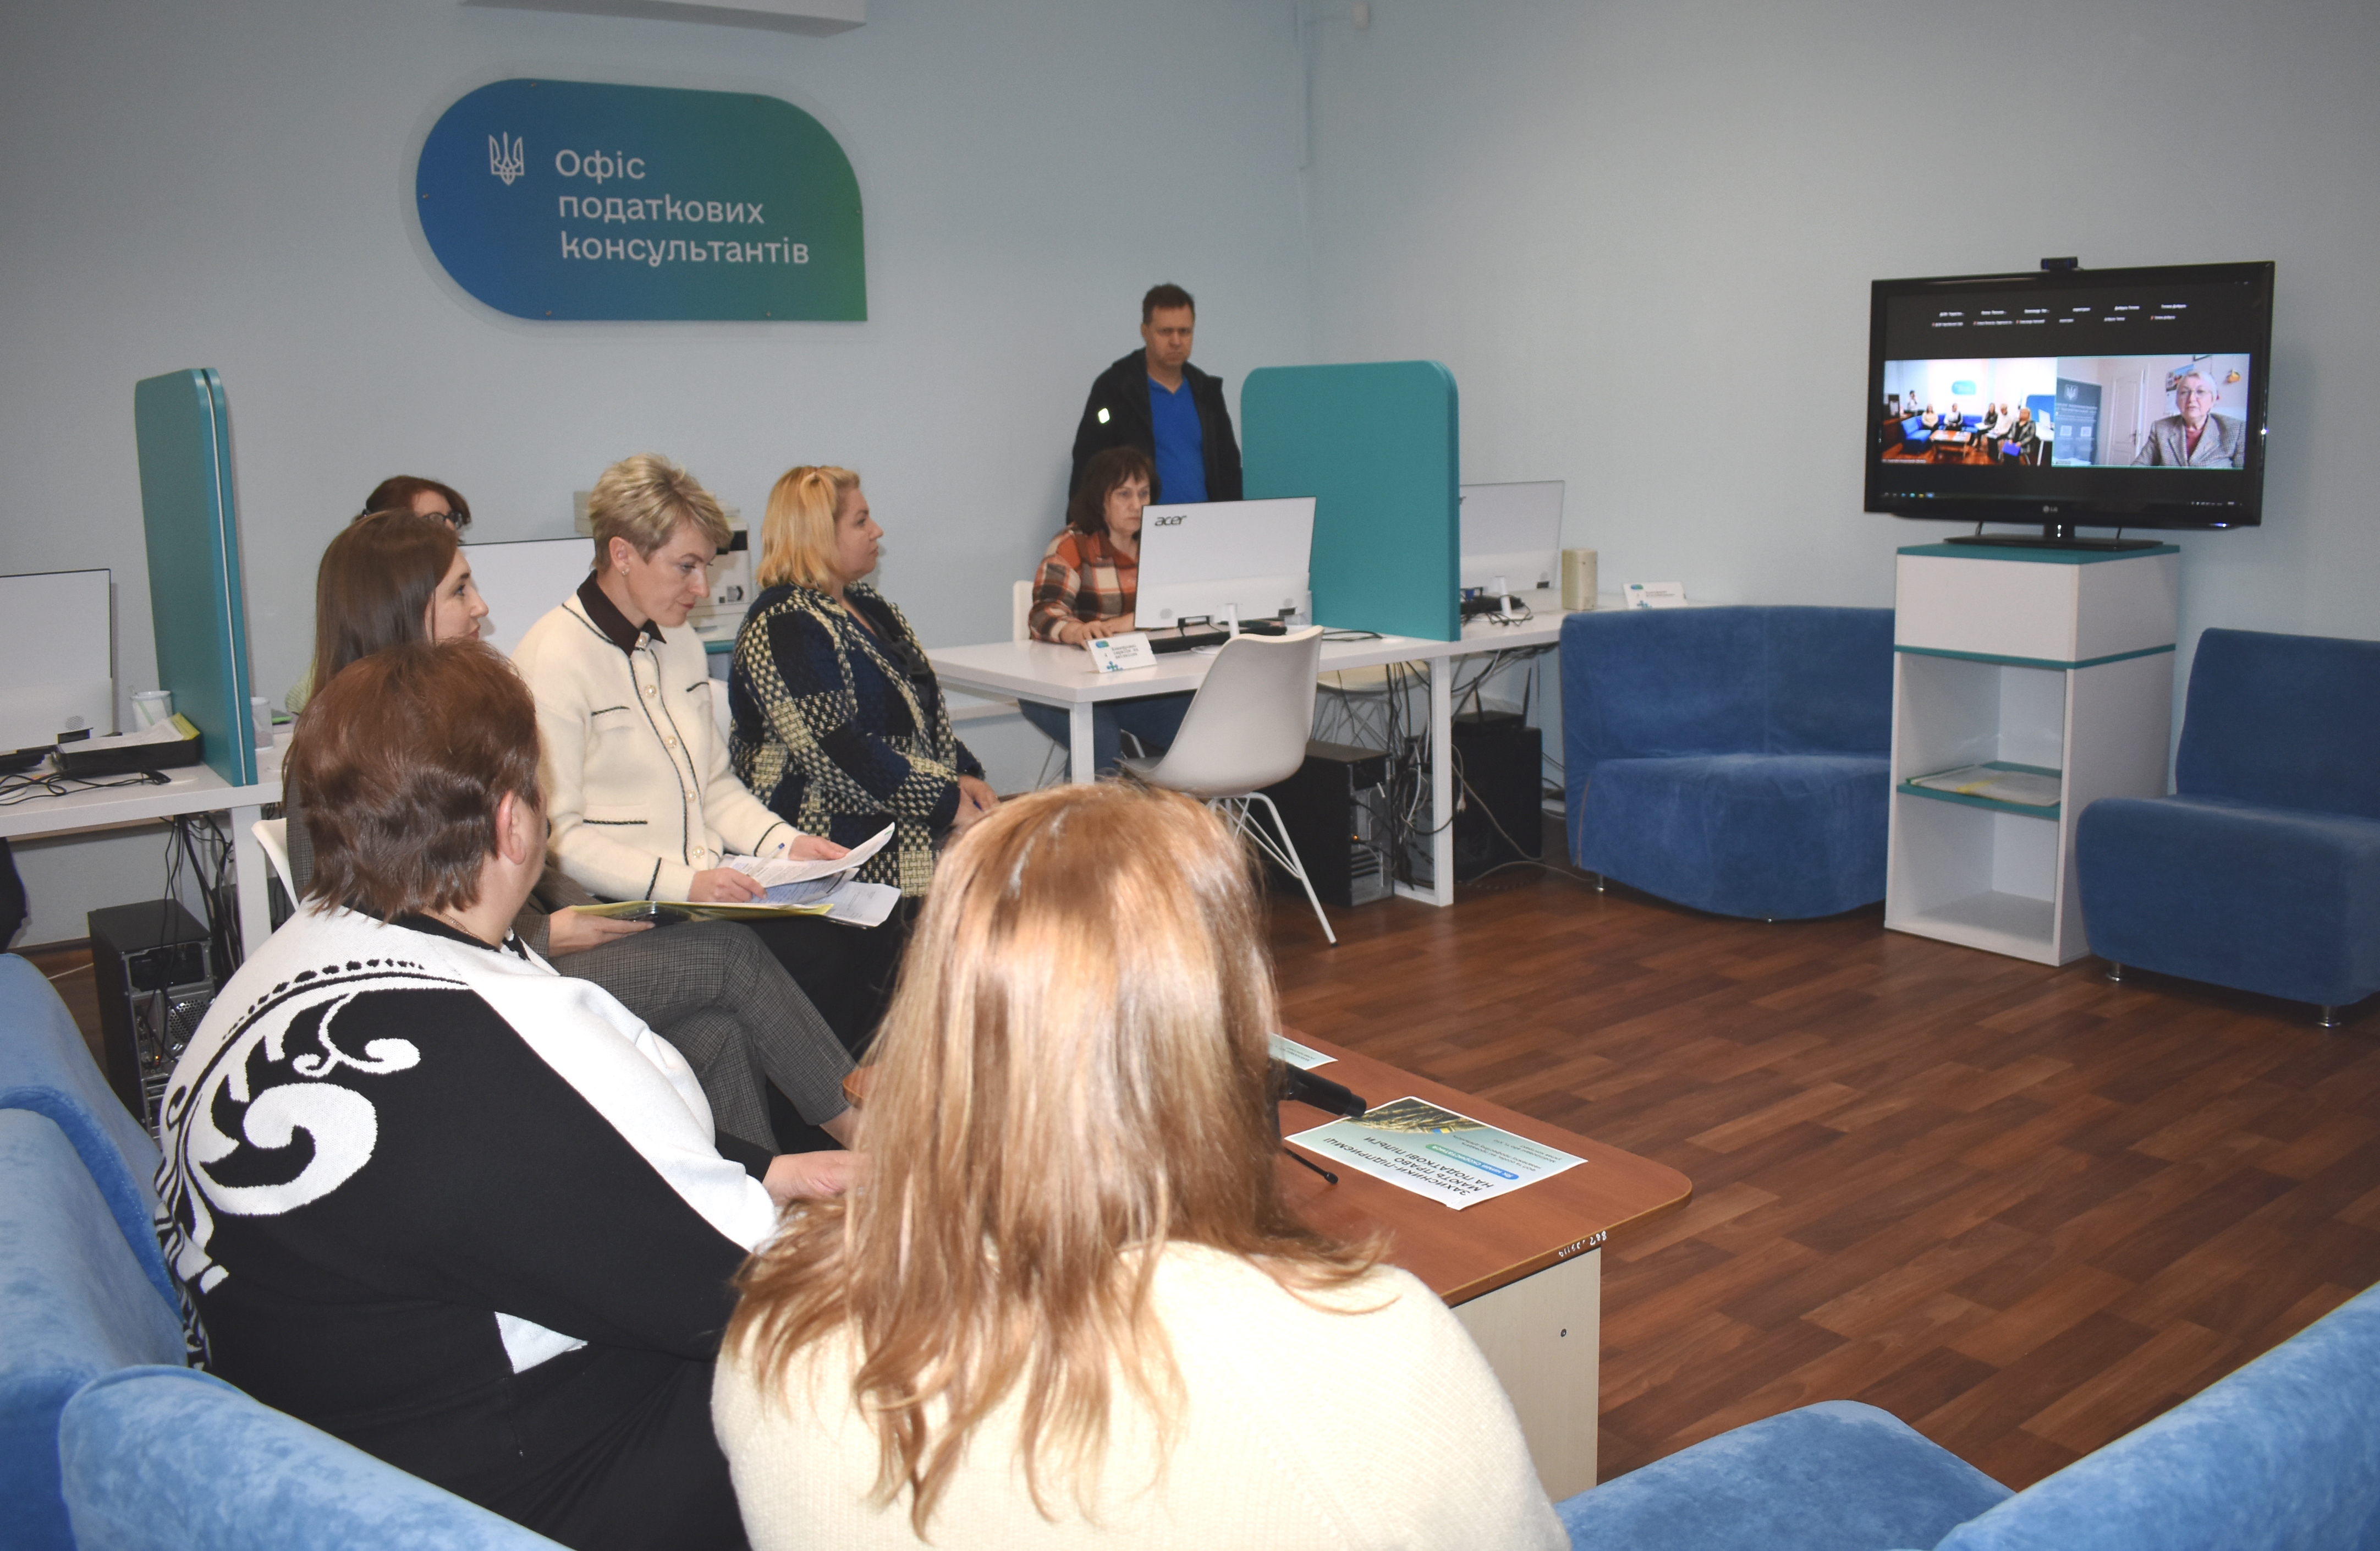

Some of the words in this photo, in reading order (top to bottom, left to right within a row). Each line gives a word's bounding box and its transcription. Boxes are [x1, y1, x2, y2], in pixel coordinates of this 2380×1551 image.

[555, 149, 646, 184] Офіс
[559, 194, 765, 223] податкових
[560, 231, 809, 267] консультантів
[1155, 515, 1187, 526] acer
[1361, 1136, 1408, 1154] ПІЛЬГИ
[1321, 1137, 1471, 1196] ЗАХИСНИКИ-ПІДПРИЄМЦІ
[1391, 1157, 1436, 1174] ПРАВО
[1404, 1152, 1476, 1181] ПОДАТКОВІ
[1432, 1172, 1483, 1192] МАЮТЬ
[1471, 1179, 1495, 1188] НА
